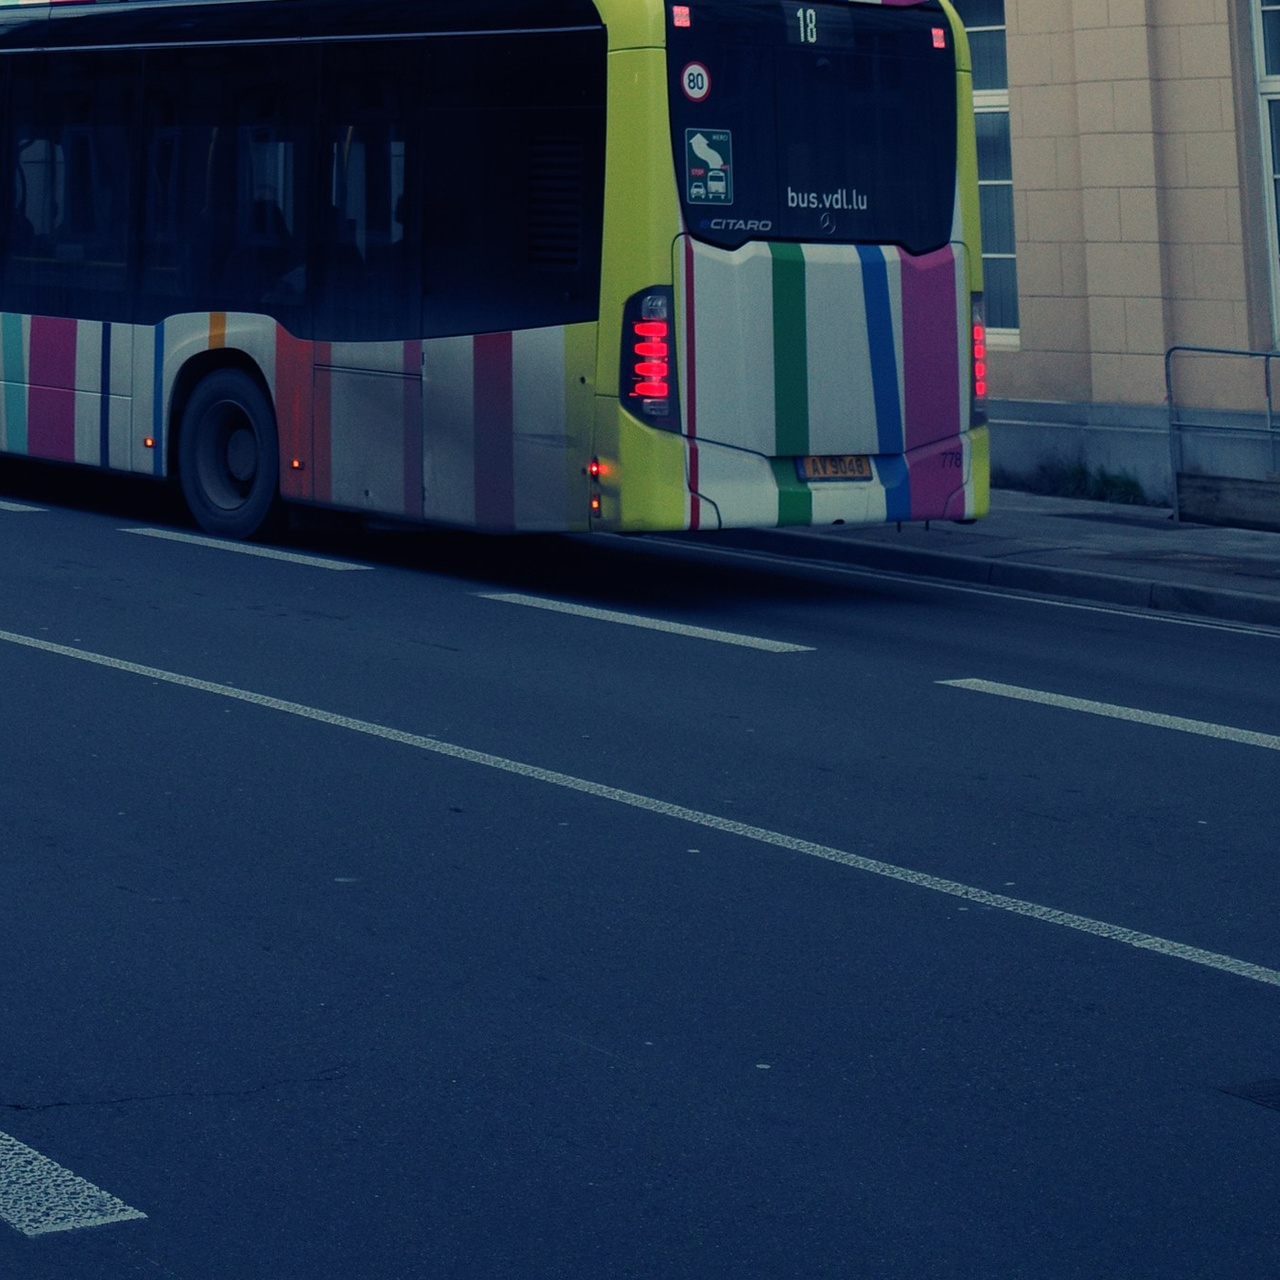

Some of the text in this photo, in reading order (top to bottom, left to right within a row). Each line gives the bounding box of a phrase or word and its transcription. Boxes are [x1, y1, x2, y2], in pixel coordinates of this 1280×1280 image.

[796, 7, 817, 43] 18
[687, 73, 704, 90] 80
[787, 186, 868, 211] bus.vdl.lu
[940, 452, 963, 469] 778
